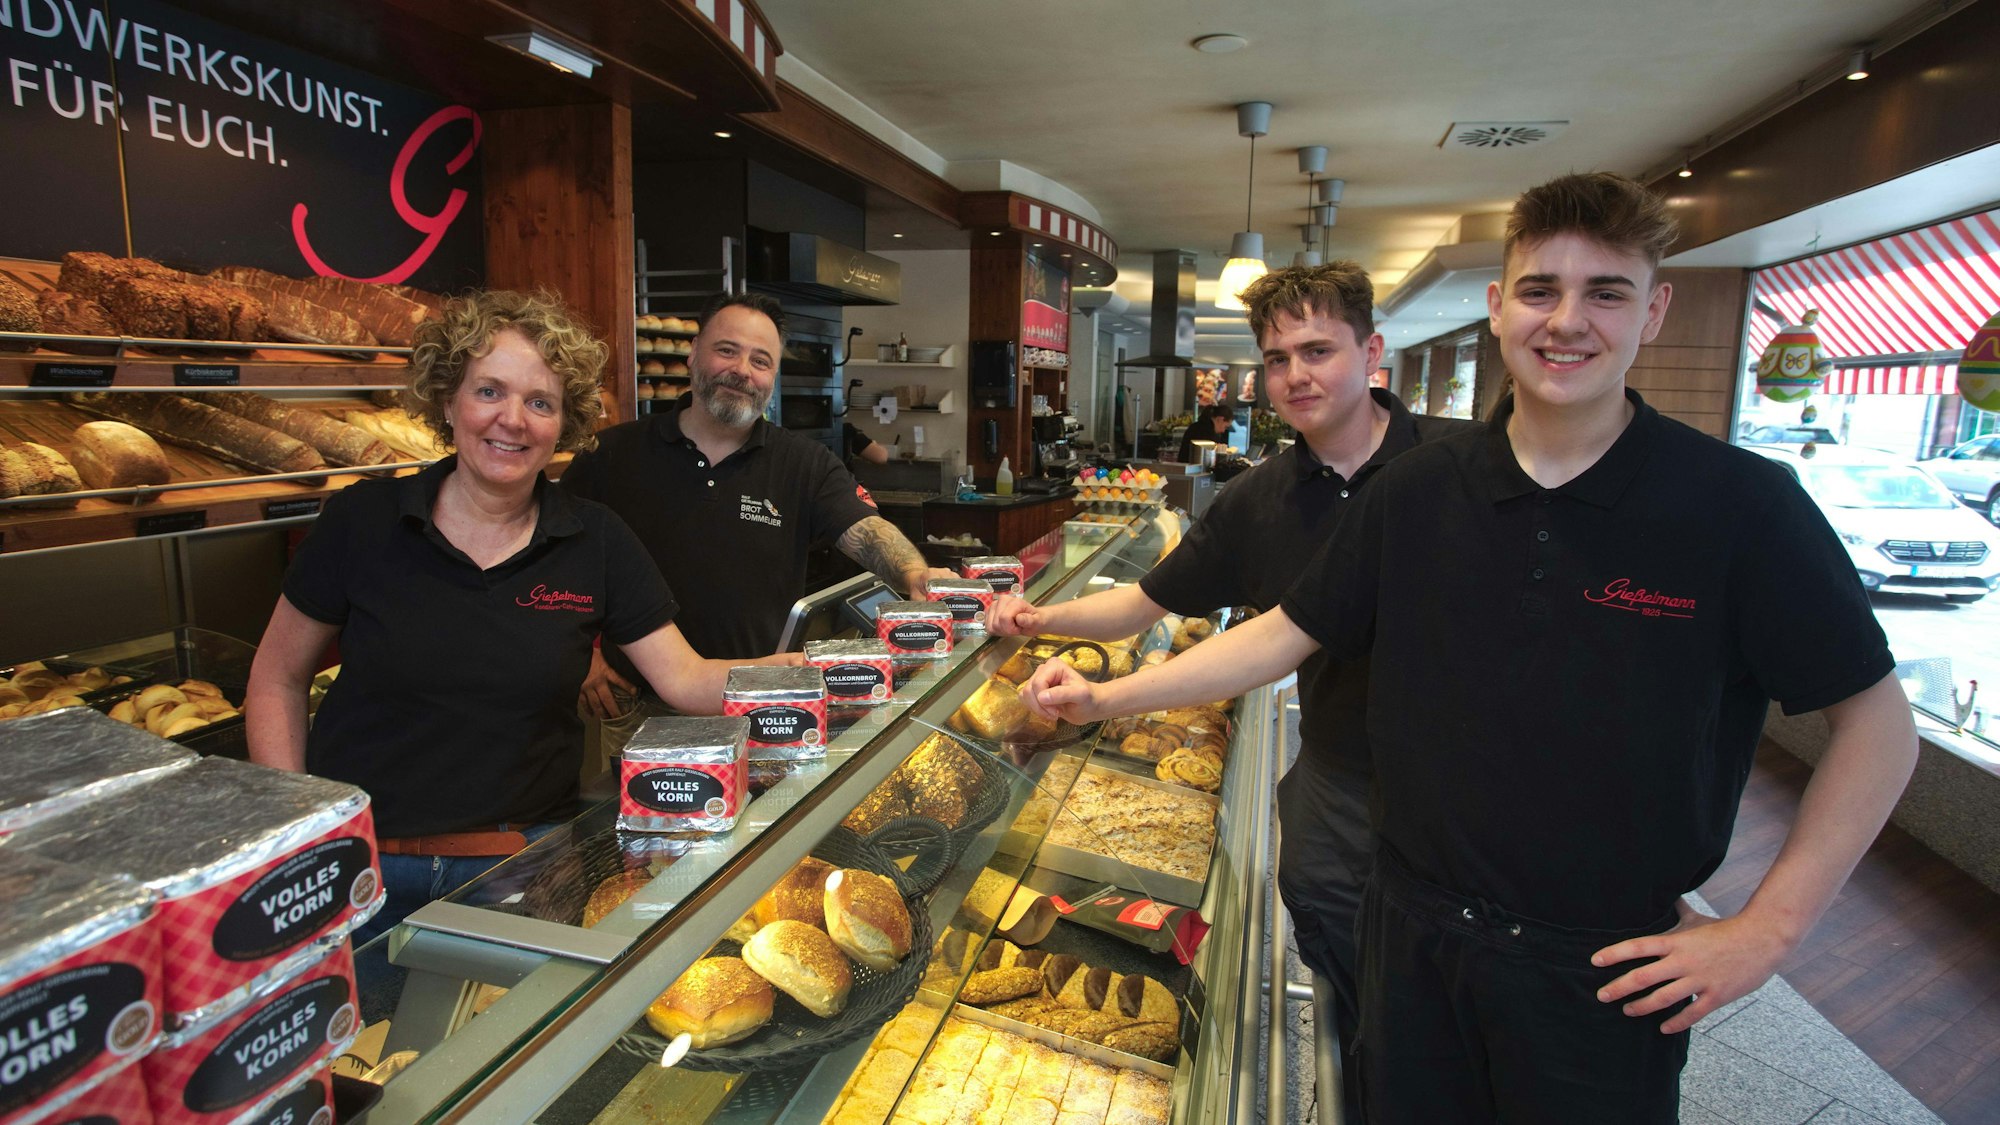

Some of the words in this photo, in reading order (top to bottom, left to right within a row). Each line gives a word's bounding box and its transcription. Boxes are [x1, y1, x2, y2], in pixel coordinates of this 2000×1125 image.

[9, 57, 130, 132] FÜR
[147, 95, 288, 167] EUCH.
[740, 504, 762, 514] BROT
[739, 512, 782, 527] SOMMELIER
[1583, 578, 1696, 609] Gießelmann
[1641, 607, 1662, 617] 1925
[825, 674, 878, 682] VOLLKORNBROT
[757, 717, 798, 726] VOLLES
[762, 726, 793, 735] KORN
[652, 780, 700, 791] VOLLES
[657, 792, 694, 802] KORN
[260, 860, 340, 916] VOLLES
[273, 886, 333, 934] KORN
[234, 1001, 317, 1065] VOLLES
[246, 1027, 309, 1080] KORN
